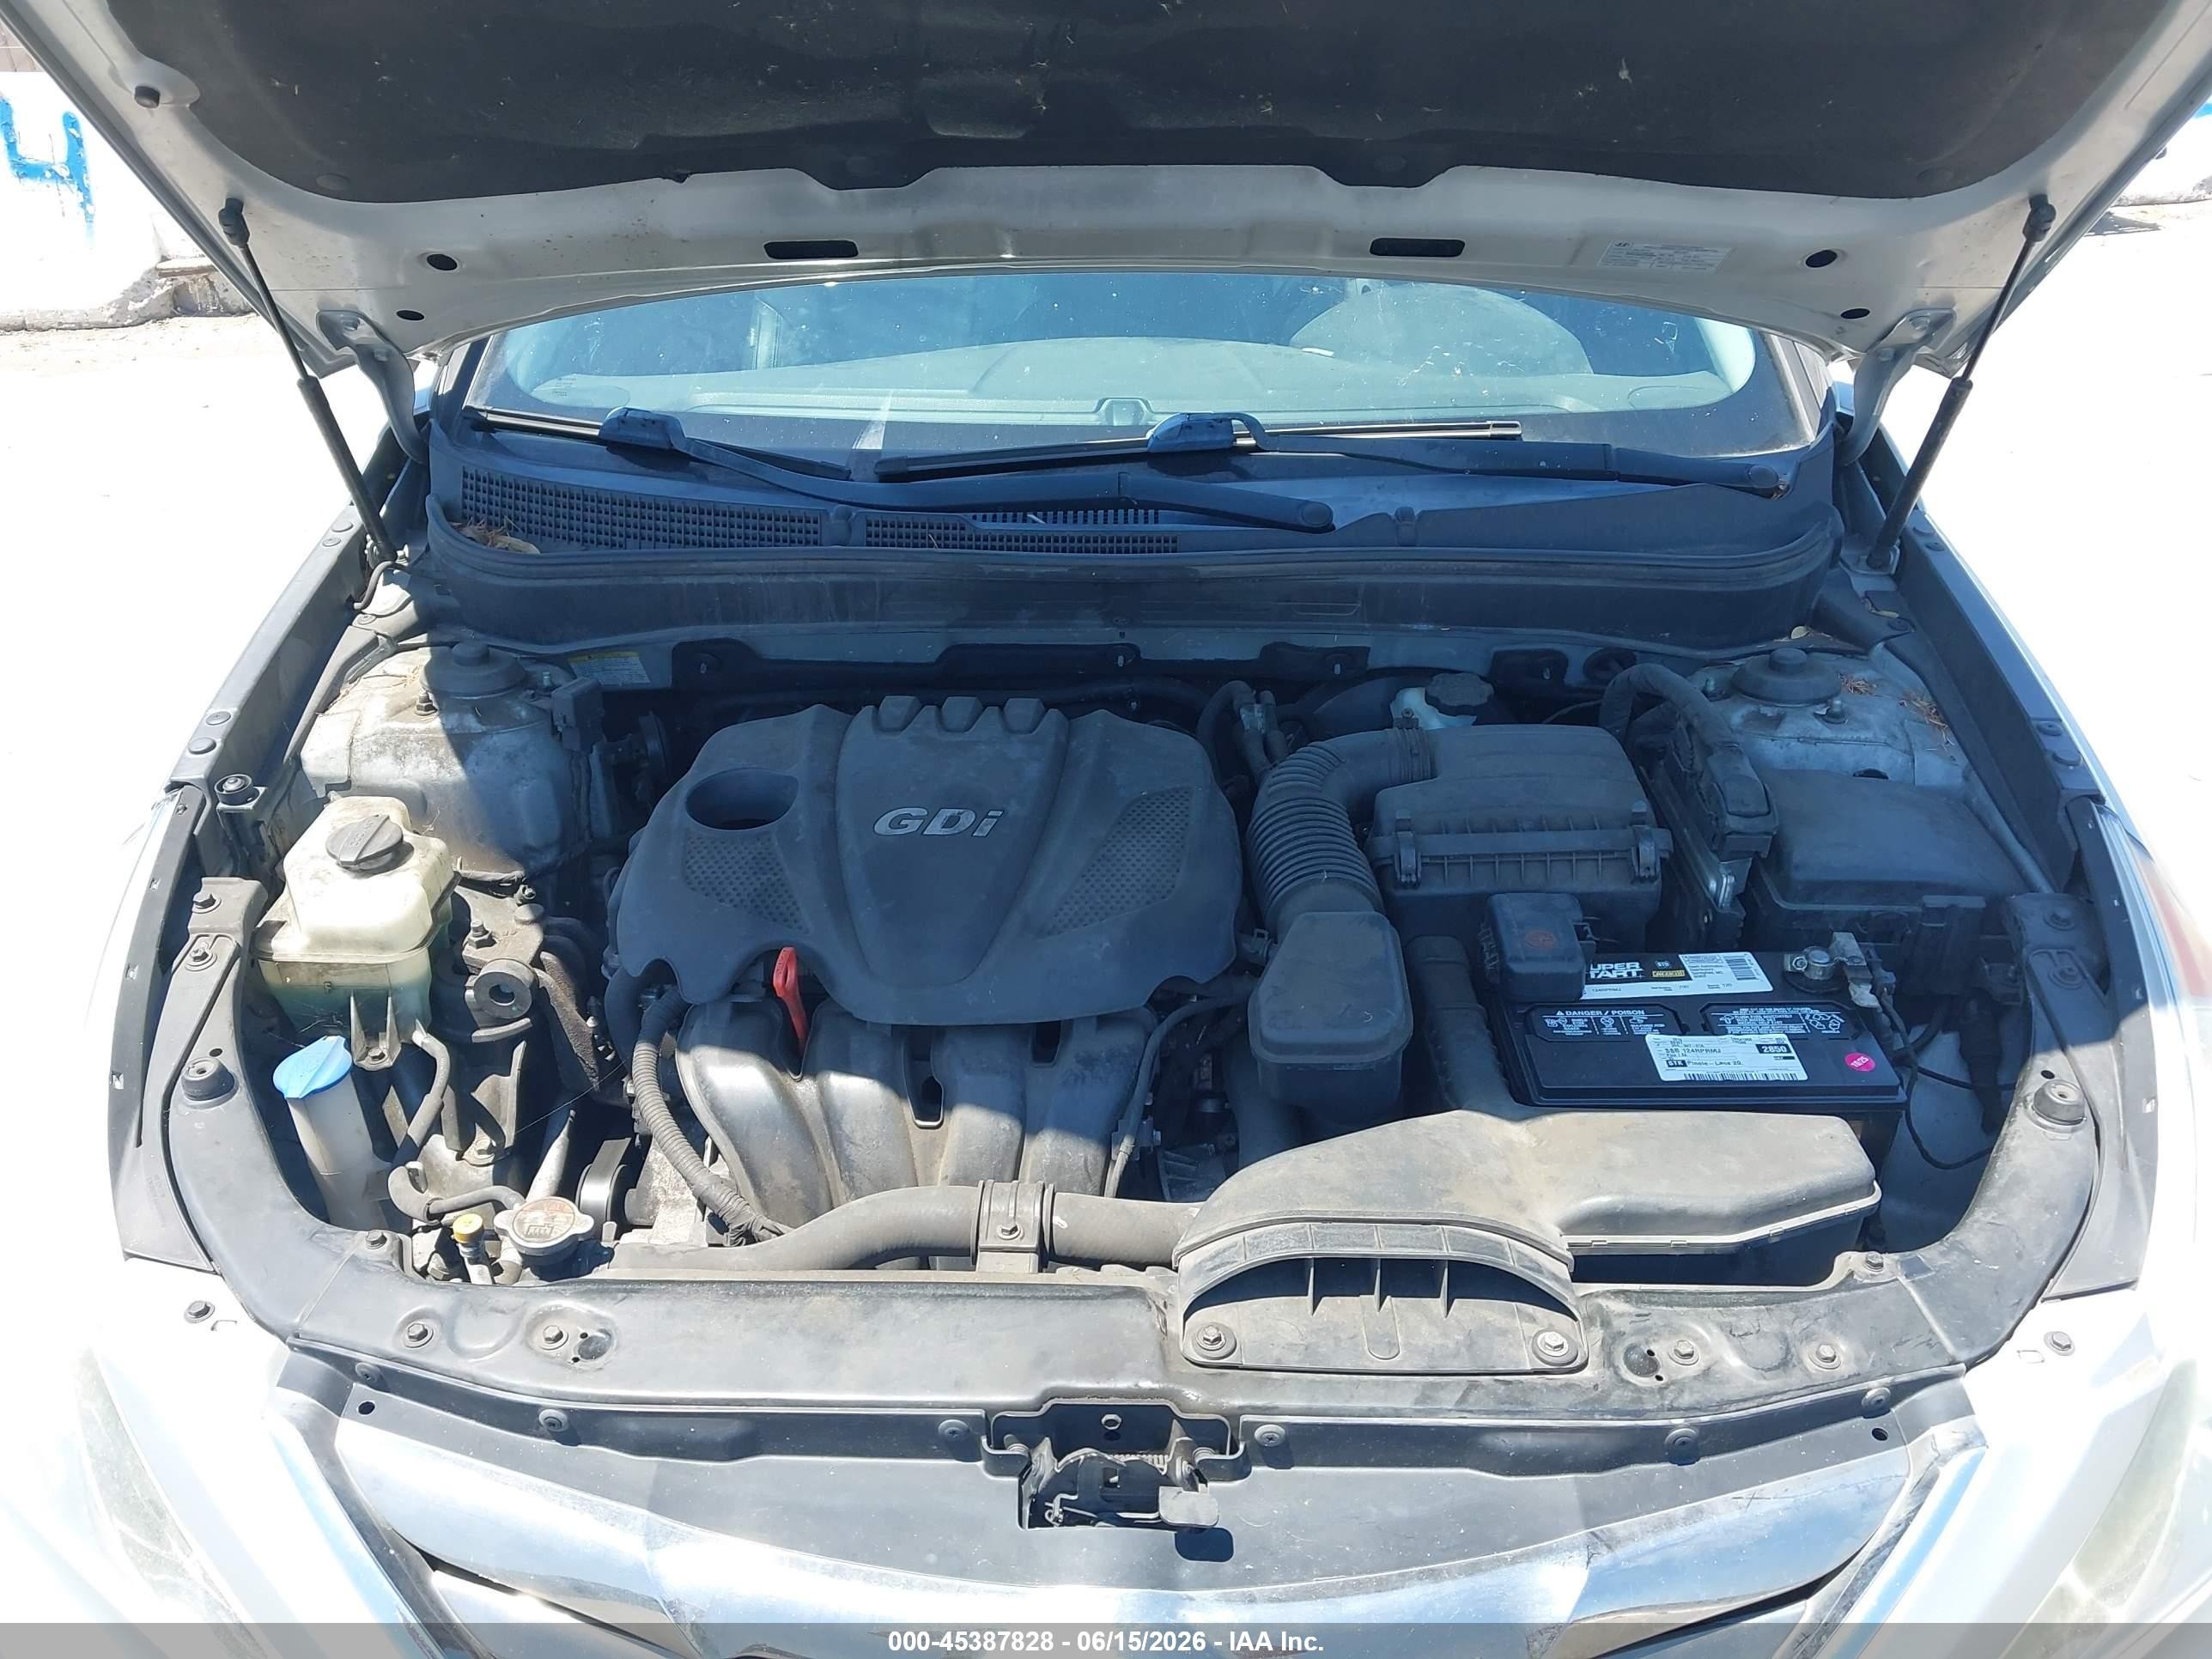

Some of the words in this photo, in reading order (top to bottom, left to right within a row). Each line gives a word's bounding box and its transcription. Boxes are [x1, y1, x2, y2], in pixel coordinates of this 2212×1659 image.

[873, 806, 1005, 838] GDi
[1590, 962, 1641, 971] UPER
[1589, 969, 1644, 980] TART
